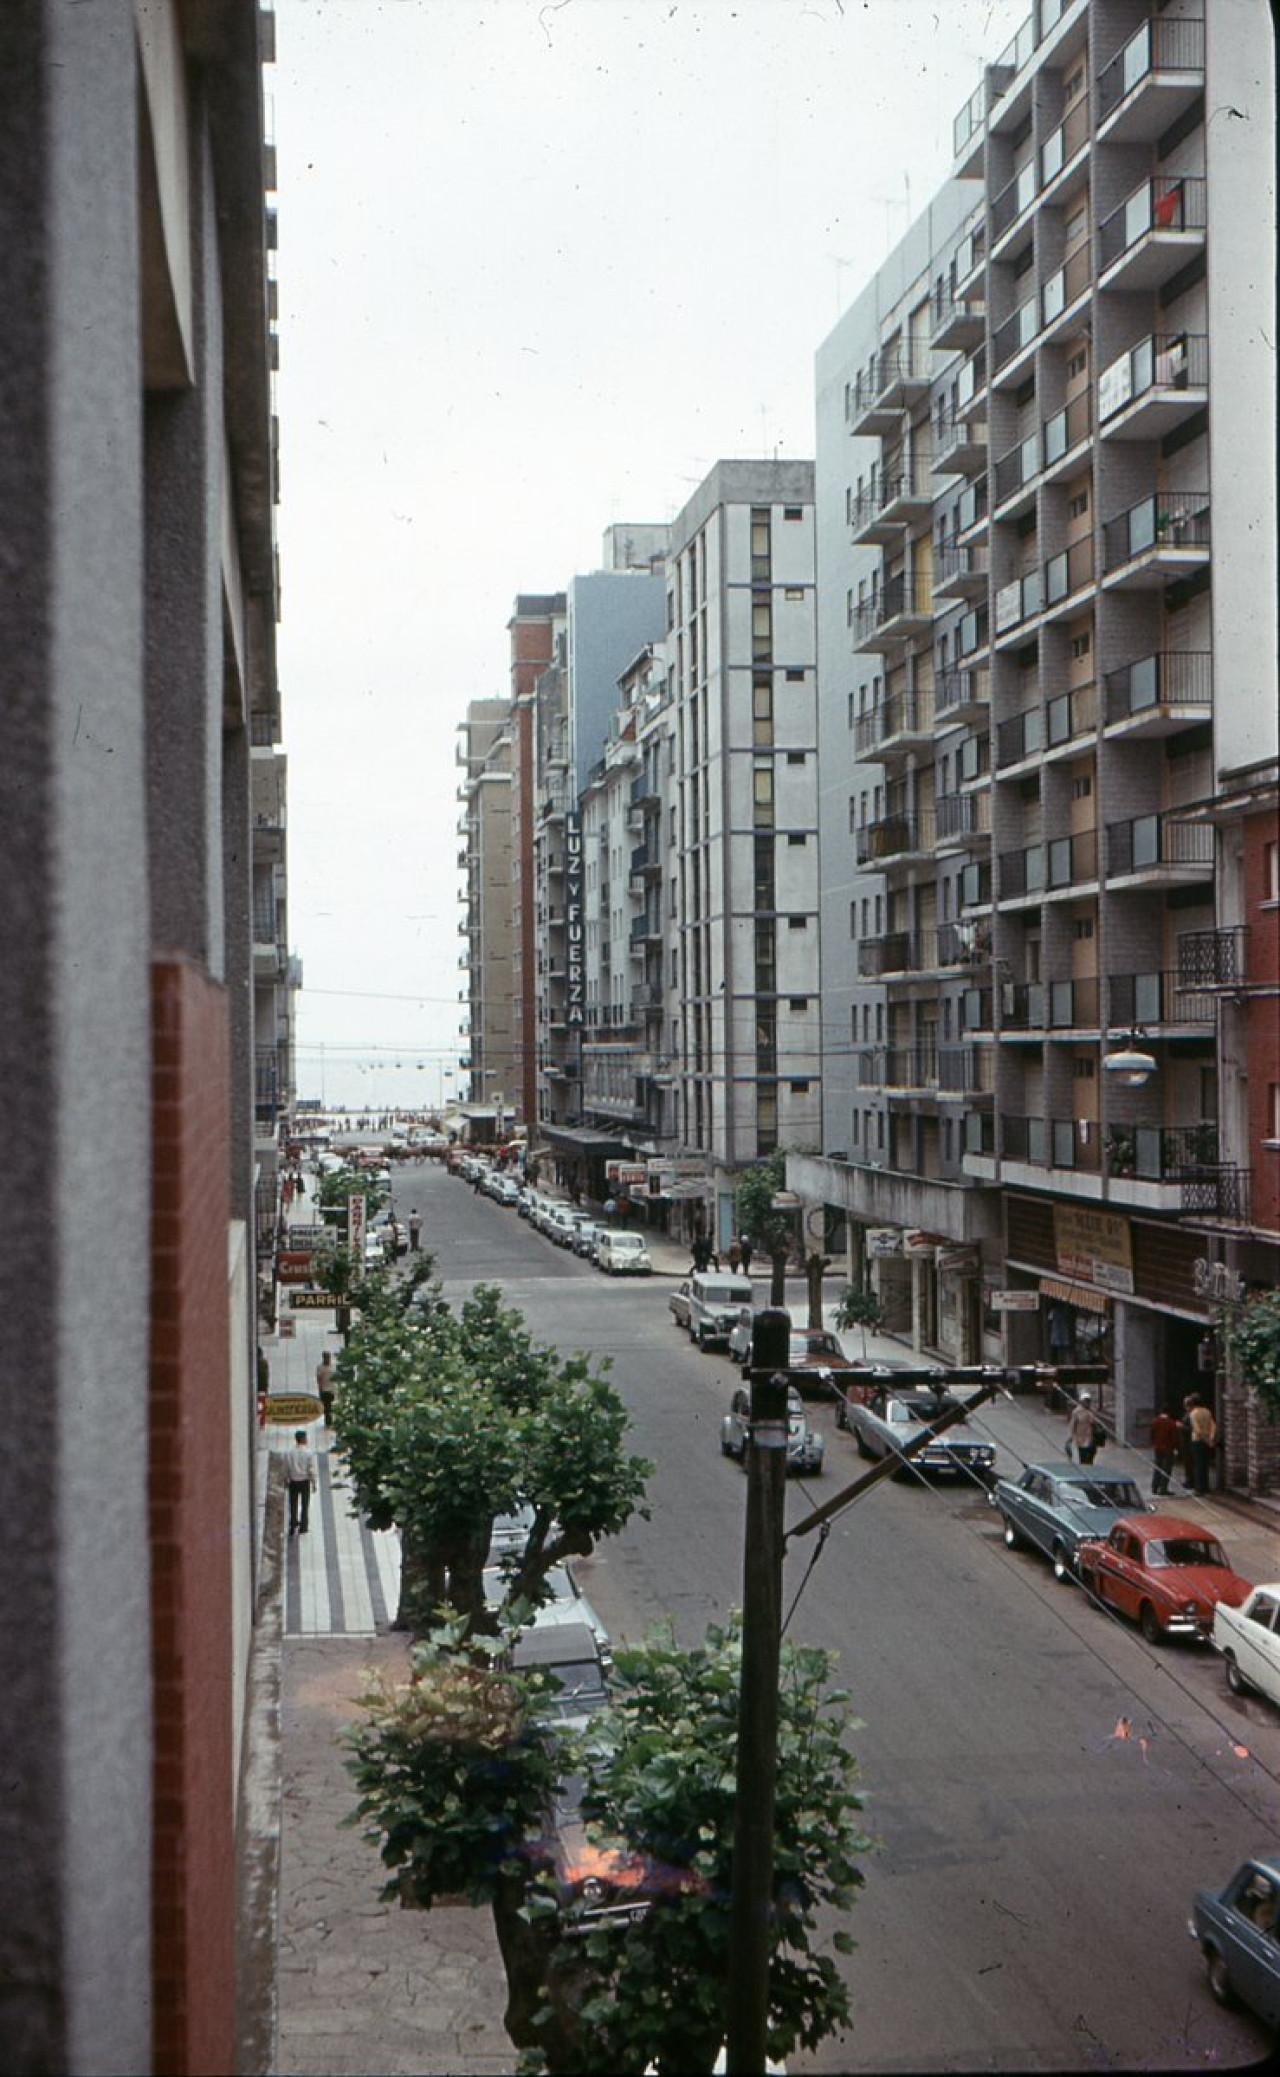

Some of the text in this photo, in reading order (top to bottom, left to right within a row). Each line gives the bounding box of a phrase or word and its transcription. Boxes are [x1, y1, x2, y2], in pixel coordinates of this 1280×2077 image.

[568, 815, 583, 1022] LUZ Y FUERZA
[295, 1294, 351, 1306] PARRIL
